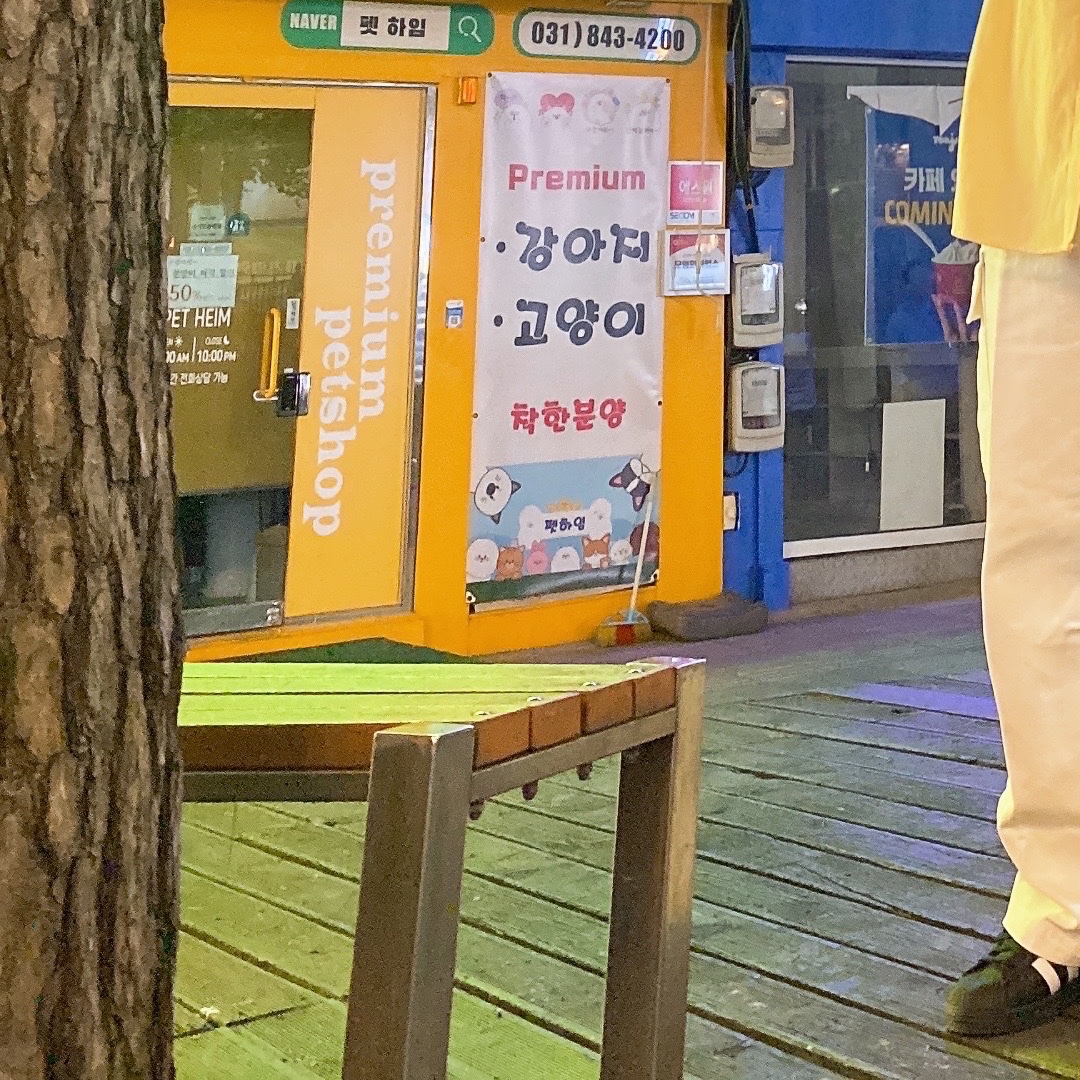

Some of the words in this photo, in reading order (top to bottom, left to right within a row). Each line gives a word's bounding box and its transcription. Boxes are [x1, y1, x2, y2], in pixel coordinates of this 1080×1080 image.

[289, 12, 338, 31] NAVER
[359, 14, 378, 37] 펫
[386, 16, 427, 39] 하임
[508, 163, 646, 191] Premium
[903, 167, 945, 193] 카페
[885, 200, 954, 225] COMIN
[515, 221, 650, 271] 강아지
[360, 159, 399, 422] premium
[194, 307, 231, 328] HEIM
[514, 298, 645, 347] 고양이
[303, 306, 357, 537] petshop
[511, 398, 627, 435] 착한분양
[544, 516, 586, 534] 펫하임
